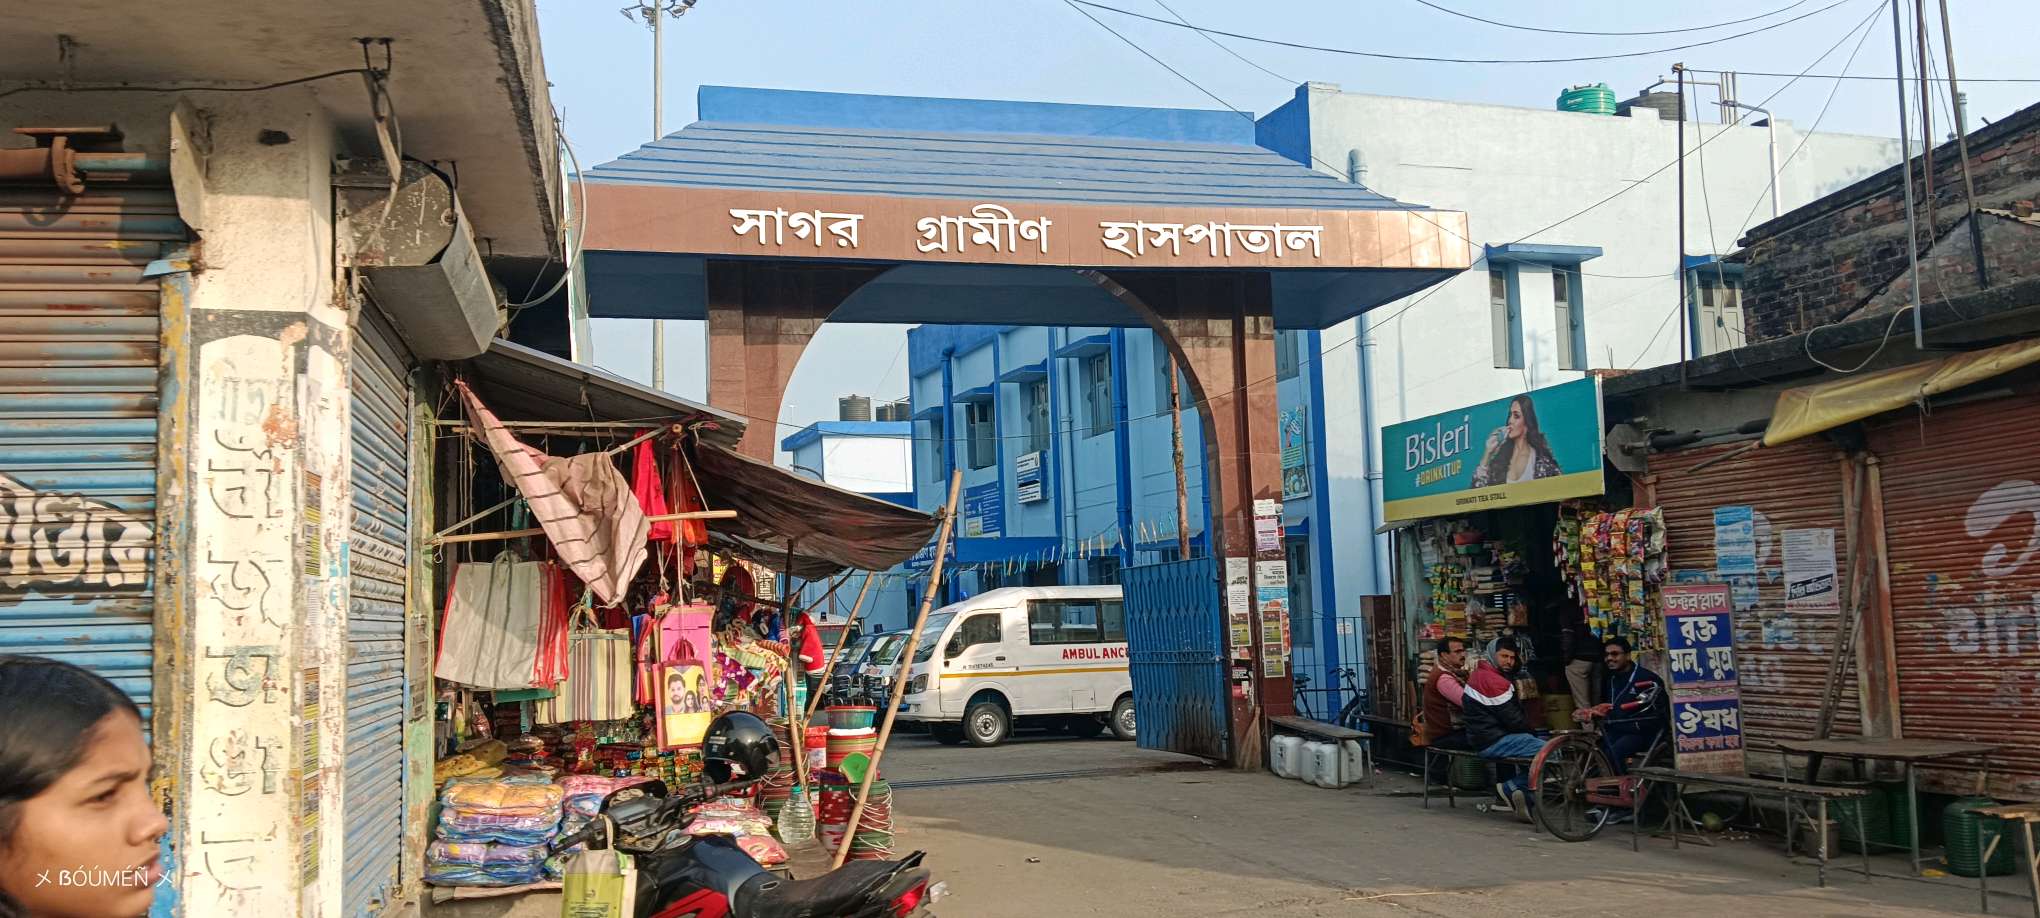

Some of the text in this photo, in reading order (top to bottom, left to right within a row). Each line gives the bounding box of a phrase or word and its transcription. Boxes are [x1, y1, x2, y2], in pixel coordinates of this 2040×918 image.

[729, 203, 1325, 258] সাগর গ্রামীণ হাসপাতাল
[1405, 415, 1471, 471] Bisleri
[1679, 615, 1718, 646] রক্ত
[1676, 703, 1738, 734] ঔষধ
